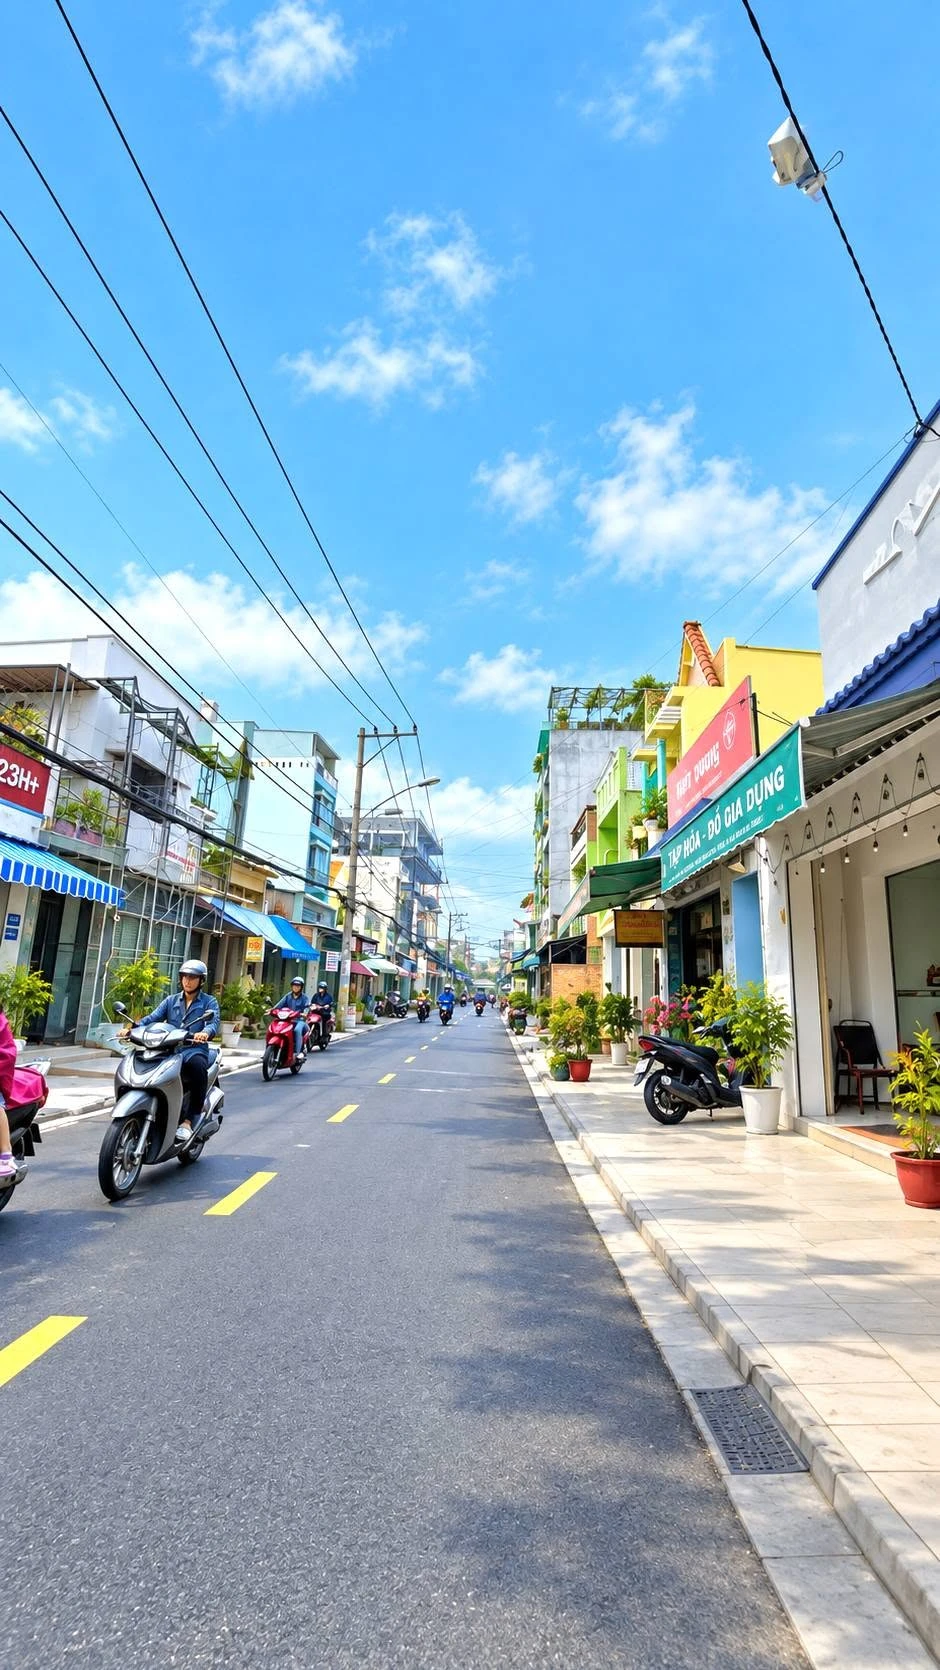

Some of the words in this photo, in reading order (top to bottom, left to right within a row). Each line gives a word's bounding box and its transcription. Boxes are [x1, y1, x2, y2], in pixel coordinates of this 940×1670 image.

[668, 844, 682, 869] TẠP
[724, 797, 743, 828] GIA
[746, 764, 785, 812] DỤNG
